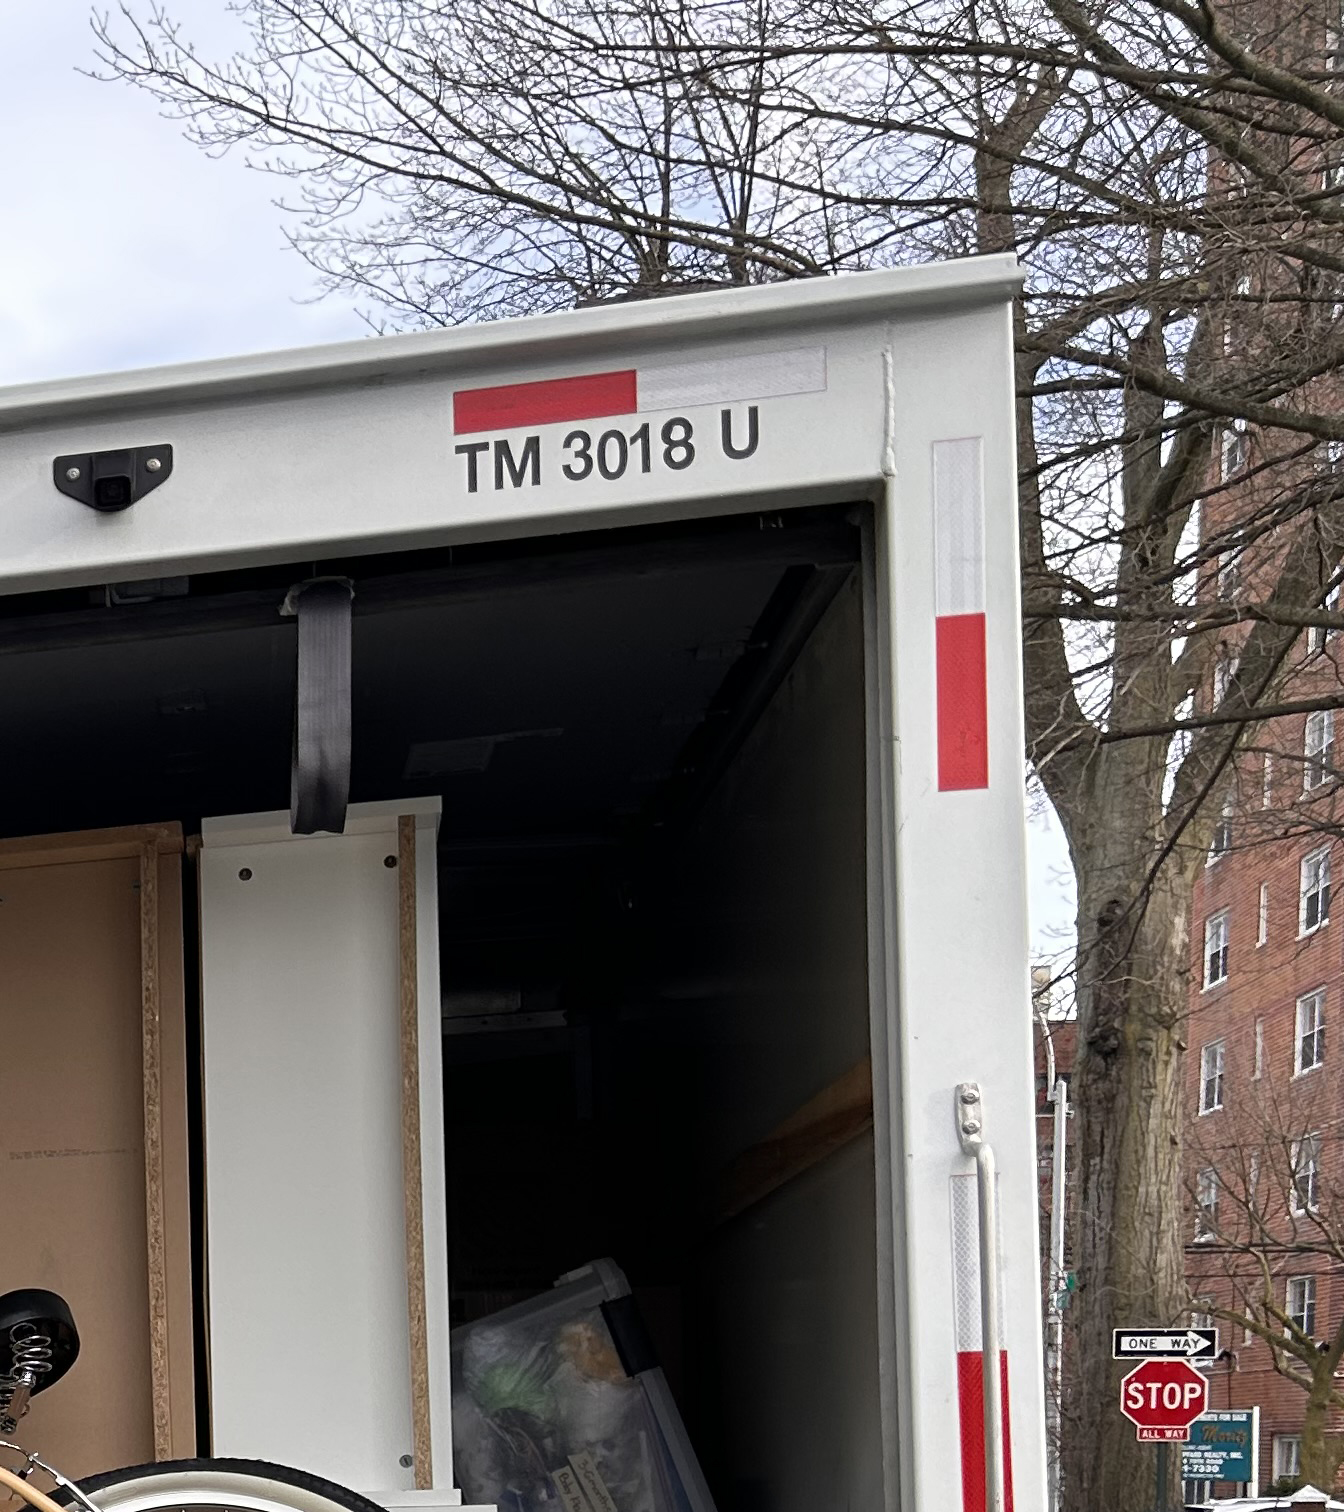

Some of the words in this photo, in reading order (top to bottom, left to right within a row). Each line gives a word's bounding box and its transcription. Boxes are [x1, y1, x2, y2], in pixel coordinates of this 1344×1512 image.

[455, 436, 541, 493] TM
[562, 416, 696, 481] 3018
[721, 406, 759, 460] U
[1129, 1338, 1157, 1349] ONE
[1171, 1338, 1200, 1349] WAY
[1126, 1382, 1202, 1410] STOP
[1142, 1430, 1158, 1438] ALL
[1164, 1430, 1184, 1438] WAY
